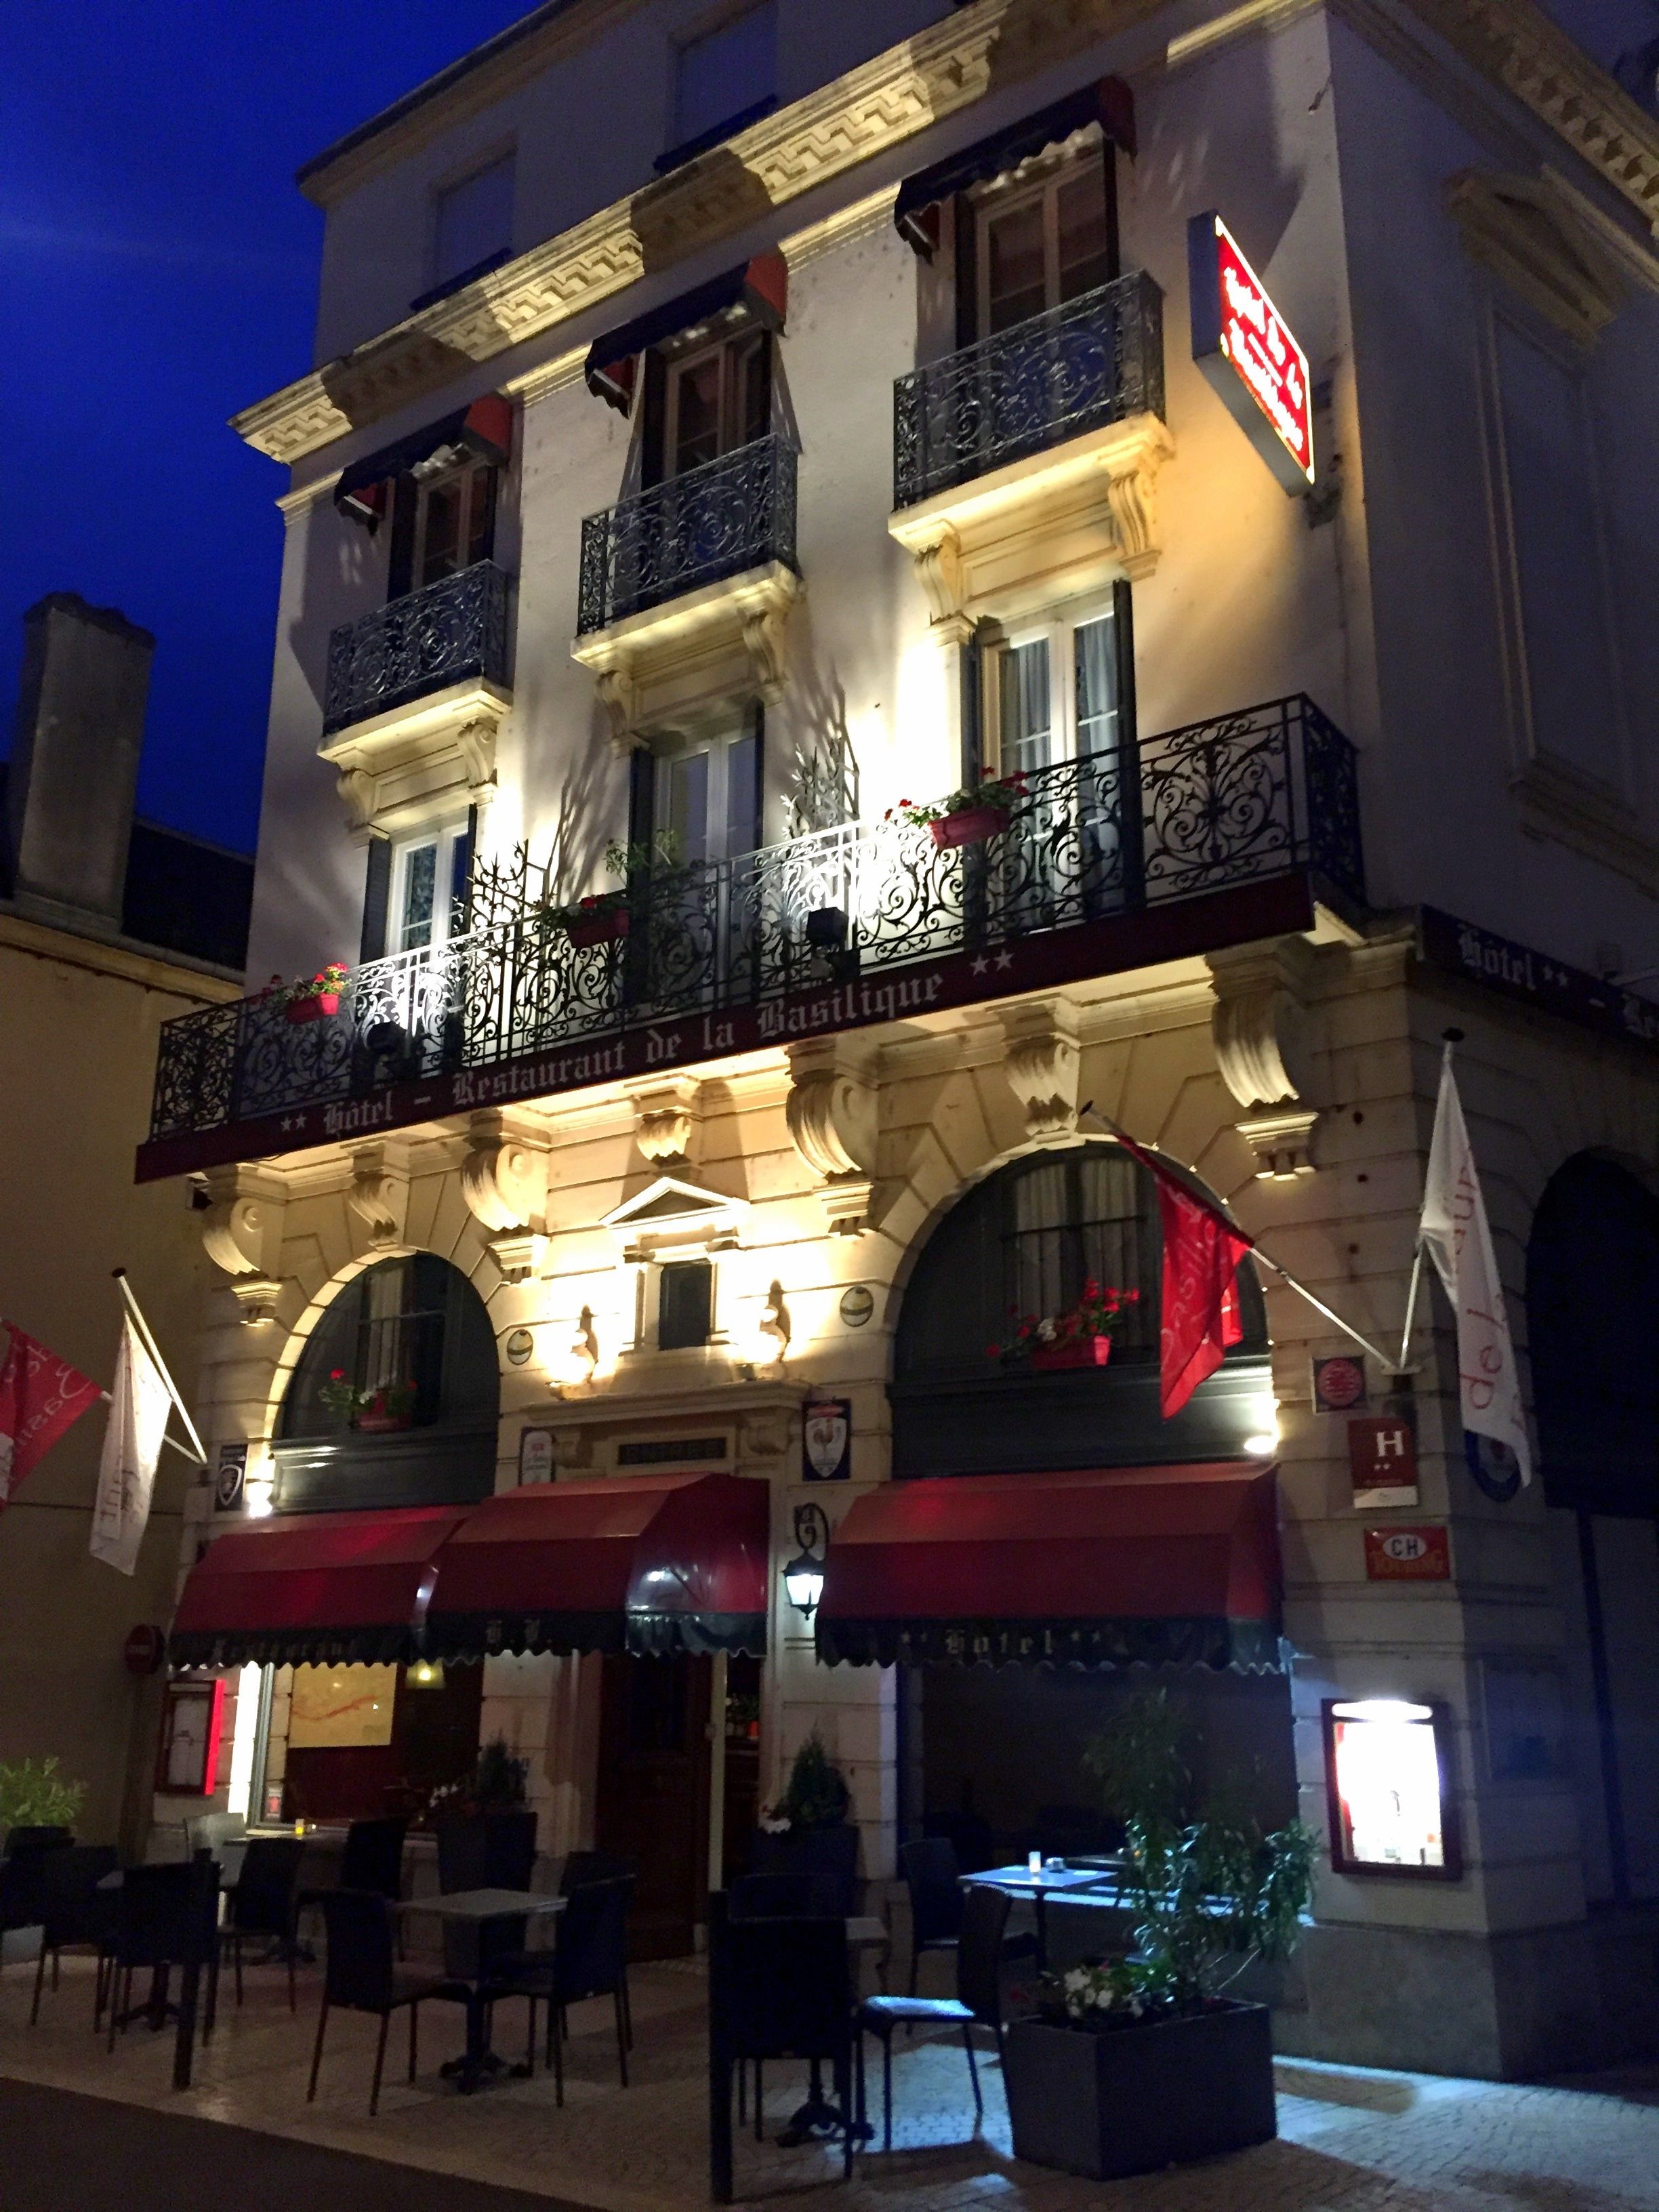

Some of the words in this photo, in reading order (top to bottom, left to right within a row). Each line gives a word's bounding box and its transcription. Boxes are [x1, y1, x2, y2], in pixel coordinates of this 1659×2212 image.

[324, 1092, 393, 1138] Hôtel
[452, 1041, 626, 1105] Restaurant
[703, 1017, 735, 1051] la
[756, 973, 945, 1039] Basilique
[1376, 1431, 1405, 1457] H
[1391, 1540, 1418, 1557] CH
